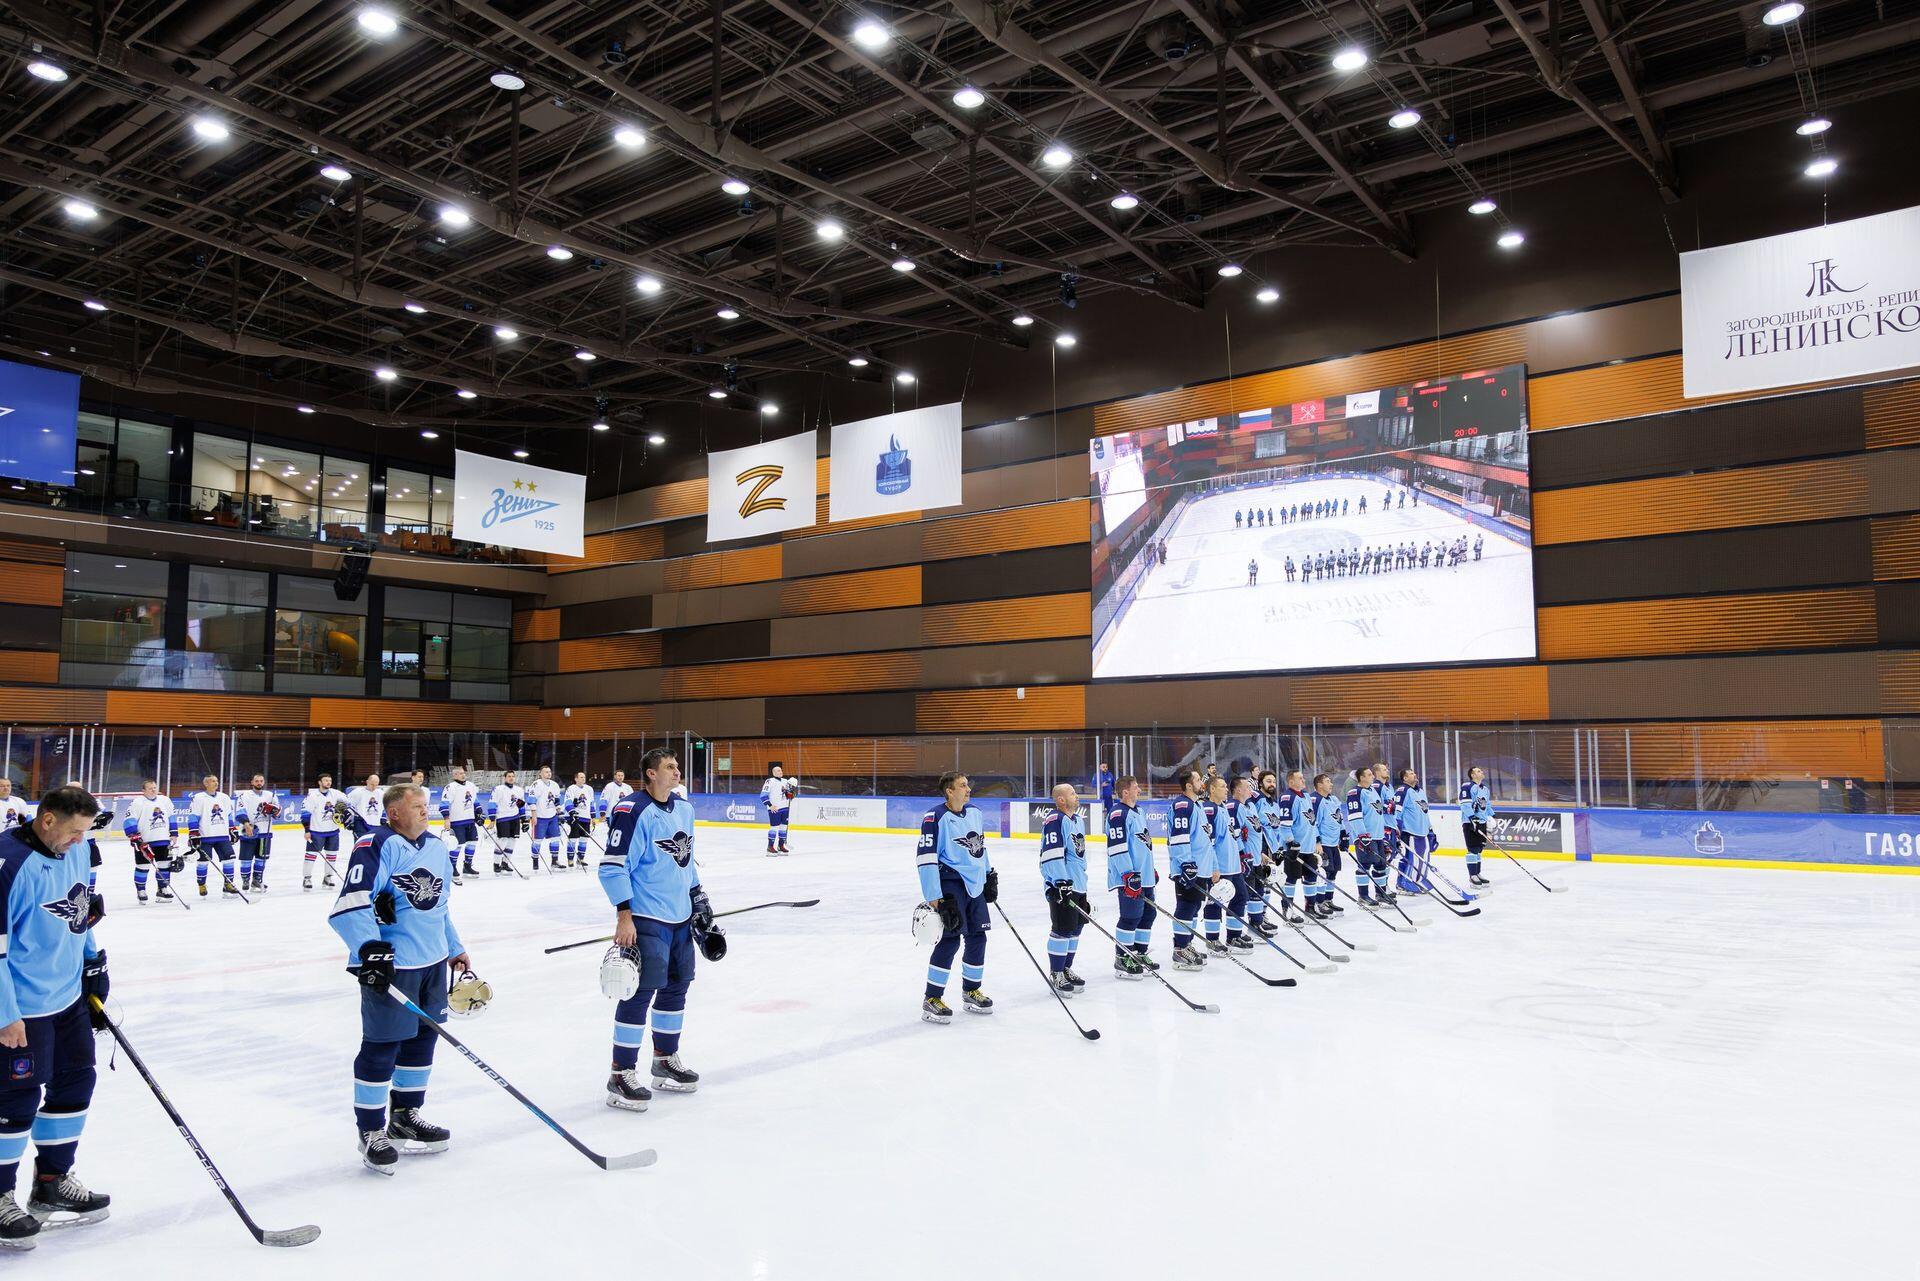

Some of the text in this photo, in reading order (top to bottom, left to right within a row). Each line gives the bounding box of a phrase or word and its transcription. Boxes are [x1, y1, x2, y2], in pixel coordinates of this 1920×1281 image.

[1726, 289, 1920, 333] ЗАГОРОДНЫЙ КЛУБ РЕПИ
[1501, 389, 1507, 397] 0
[1454, 427, 1478, 437] 20:00
[534, 519, 555, 531] 1925
[1032, 805, 1054, 820] ANG
[1145, 813, 1168, 821] КОРП
[1510, 815, 1558, 834] ANIMAL
[1045, 832, 1058, 845] 16
[367, 953, 395, 962] CC
